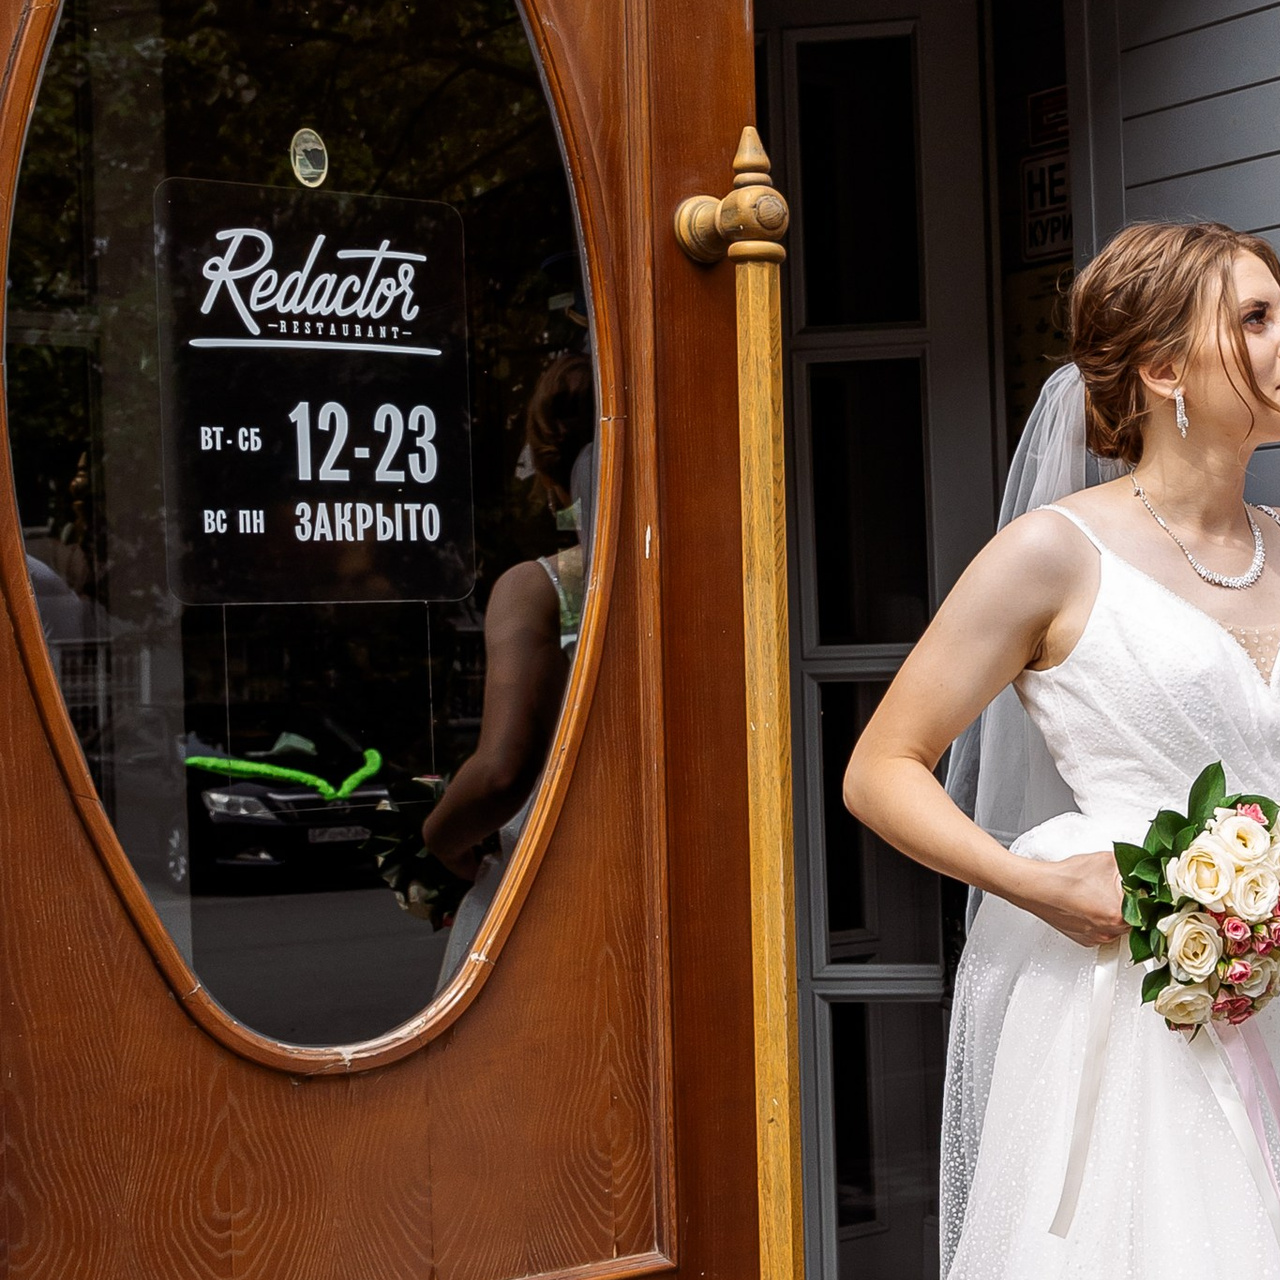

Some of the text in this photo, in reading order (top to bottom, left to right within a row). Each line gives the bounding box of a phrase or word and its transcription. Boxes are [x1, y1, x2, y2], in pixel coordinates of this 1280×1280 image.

[1027, 162, 1067, 211] НЕ
[200, 228, 427, 336] Redactor
[279, 320, 401, 339] RESTAURANT
[288, 401, 438, 484] 12-23
[203, 501, 441, 542] ВС ПН ЗАКРЫТО
